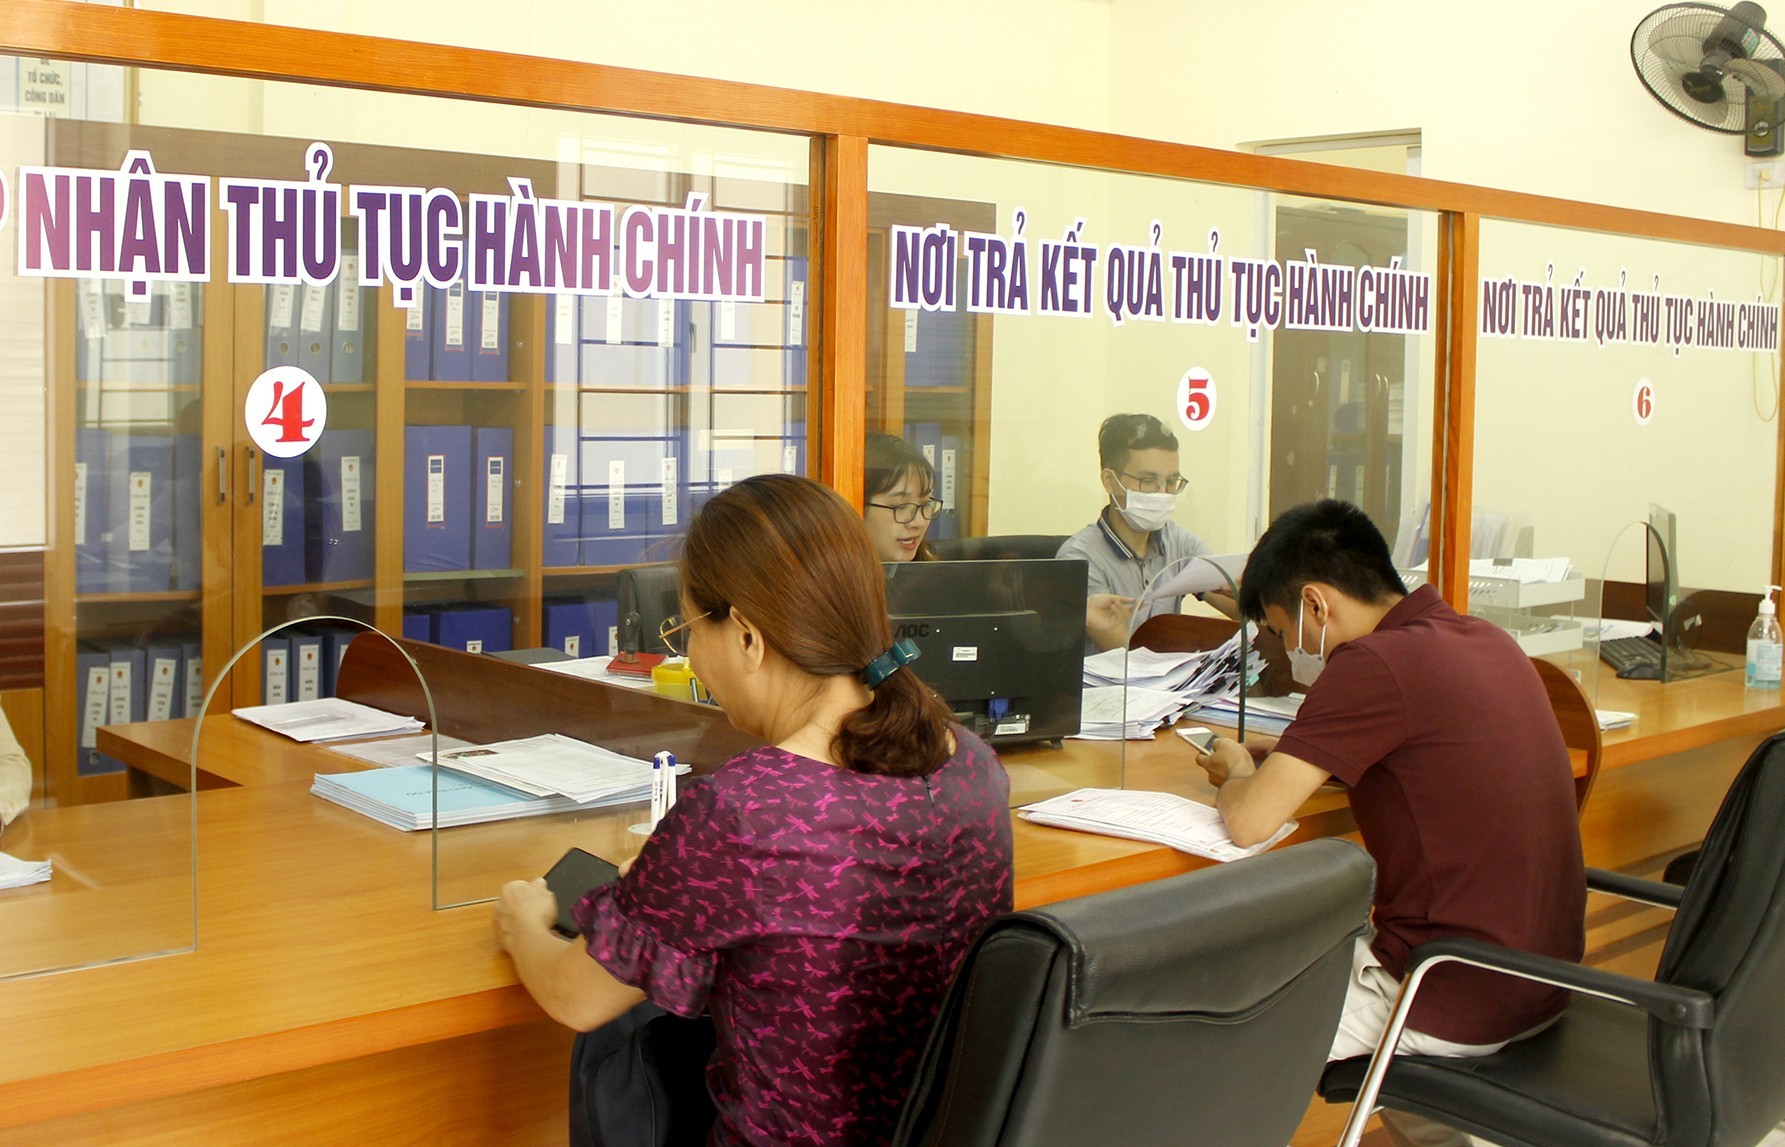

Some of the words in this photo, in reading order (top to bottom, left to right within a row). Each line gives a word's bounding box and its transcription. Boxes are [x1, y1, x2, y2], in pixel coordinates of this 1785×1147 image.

[25, 158, 206, 296] NHẬN
[227, 149, 337, 281] THỦ
[357, 192, 460, 302] TỤC
[475, 184, 612, 290] HÀNH
[624, 198, 763, 299] CHÍNH
[895, 229, 956, 306] NƠI
[968, 211, 1029, 310] TRẢ
[1041, 221, 1097, 314] KẾT
[1107, 223, 1163, 321] QUẢ
[1172, 231, 1222, 322] THỦ
[1231, 261, 1281, 338] TỤC
[1289, 253, 1353, 327] HÀNH
[1359, 260, 1430, 331] CHÍNH
[1482, 278, 1517, 335] NƠI
[1522, 263, 1554, 337] TRẢ
[1559, 271, 1591, 340] KẾT
[1595, 270, 1627, 345] QUẢ
[1632, 274, 1660, 344] THỦ
[1665, 297, 1694, 356] TỤC
[1696, 291, 1735, 348] HÀNH
[1737, 295, 1779, 350] CHÍNH
[261, 381, 315, 443] 4
[1186, 377, 1211, 422] 5
[1637, 386, 1652, 419] 6
[894, 623, 930, 638] AOC
